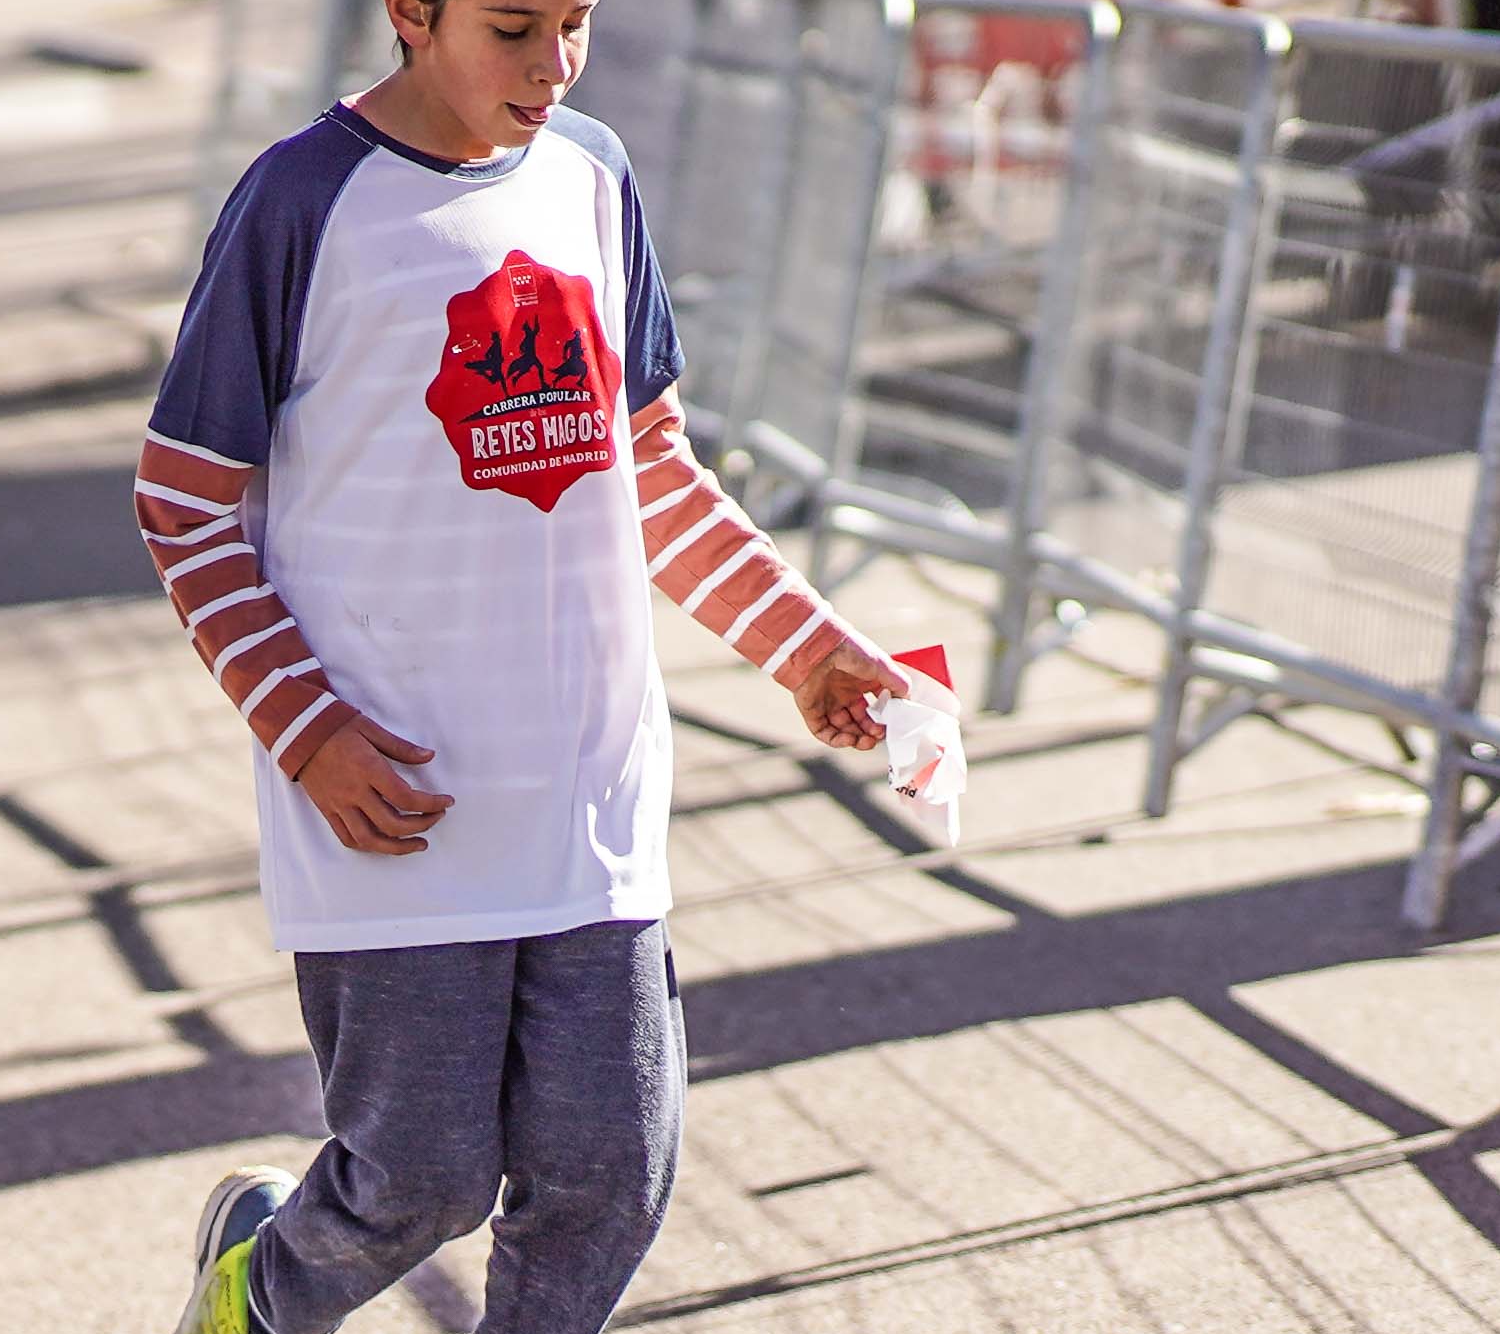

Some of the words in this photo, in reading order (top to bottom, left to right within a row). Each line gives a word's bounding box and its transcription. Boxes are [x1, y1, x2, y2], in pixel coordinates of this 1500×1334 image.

[483, 394, 537, 416] CARRERA
[471, 420, 536, 459] REYES
[542, 409, 607, 449] MAGOS
[473, 459, 547, 480] COMUNIDAD
[549, 456, 562, 468] DE
[563, 450, 609, 466] MADRID
